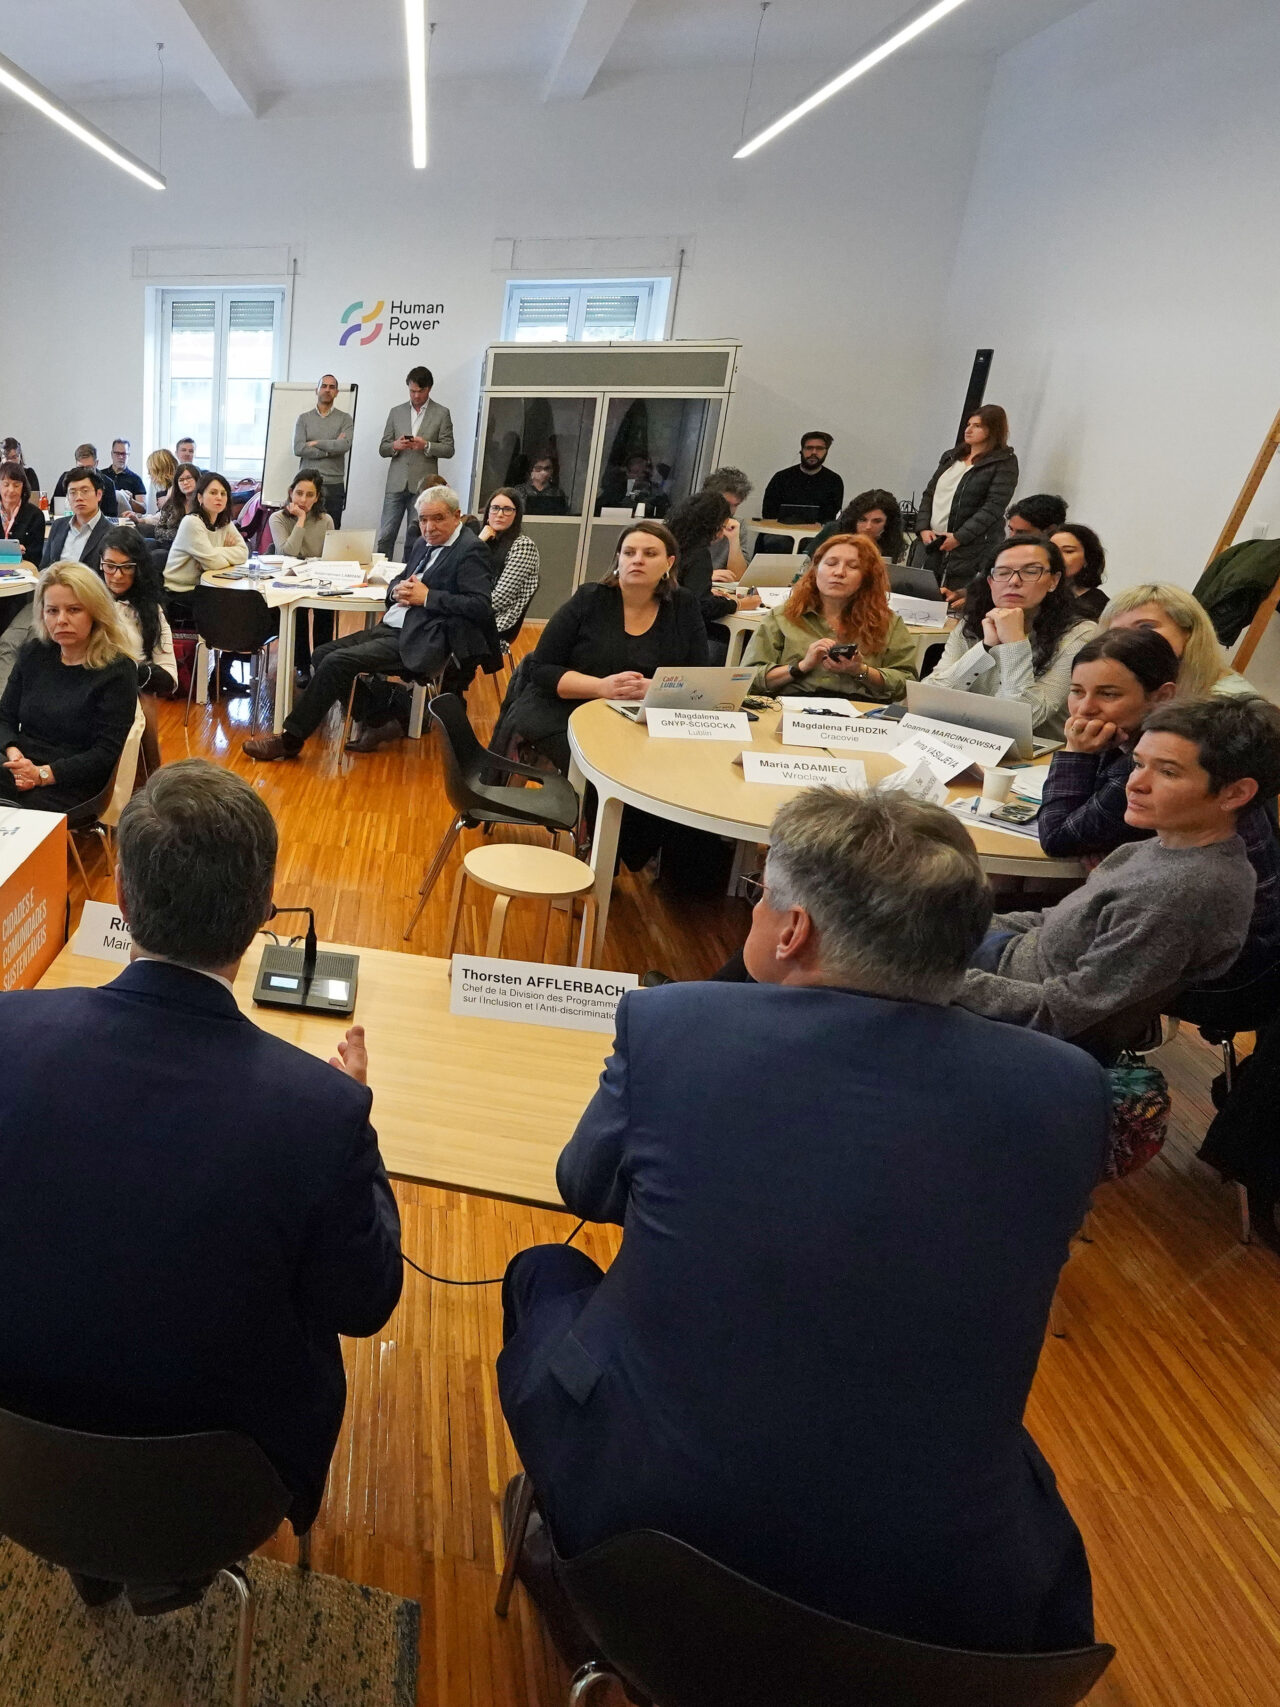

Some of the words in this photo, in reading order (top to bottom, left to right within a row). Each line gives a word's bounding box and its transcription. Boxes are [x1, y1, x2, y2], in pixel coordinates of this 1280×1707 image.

[391, 300, 444, 314] Human
[389, 317, 440, 330] Power
[388, 333, 420, 346] Hub
[674, 712, 720, 721] Magdalena
[792, 721, 842, 732] Magdalena
[845, 725, 888, 735] FURDZIK
[820, 732, 859, 742] Cracovie
[902, 722, 931, 734] Joanna
[931, 729, 1002, 751] MARCINKOWSKA
[759, 760, 790, 770] Maria
[794, 763, 848, 774] ADAMIEC
[2, 892, 30, 942] CIDADES
[2, 898, 47, 969] COMUNIDADES
[462, 968, 522, 986] Thorsten
[526, 976, 626, 997] AFFLERBACH
[462, 983, 483, 993] Chef
[485, 986, 497, 995] de
[499, 987, 507, 996] la
[509, 989, 545, 1000] Division
[546, 993, 563, 1003] des
[463, 995, 477, 1003] sur
[525, 1002, 534, 1010] et
